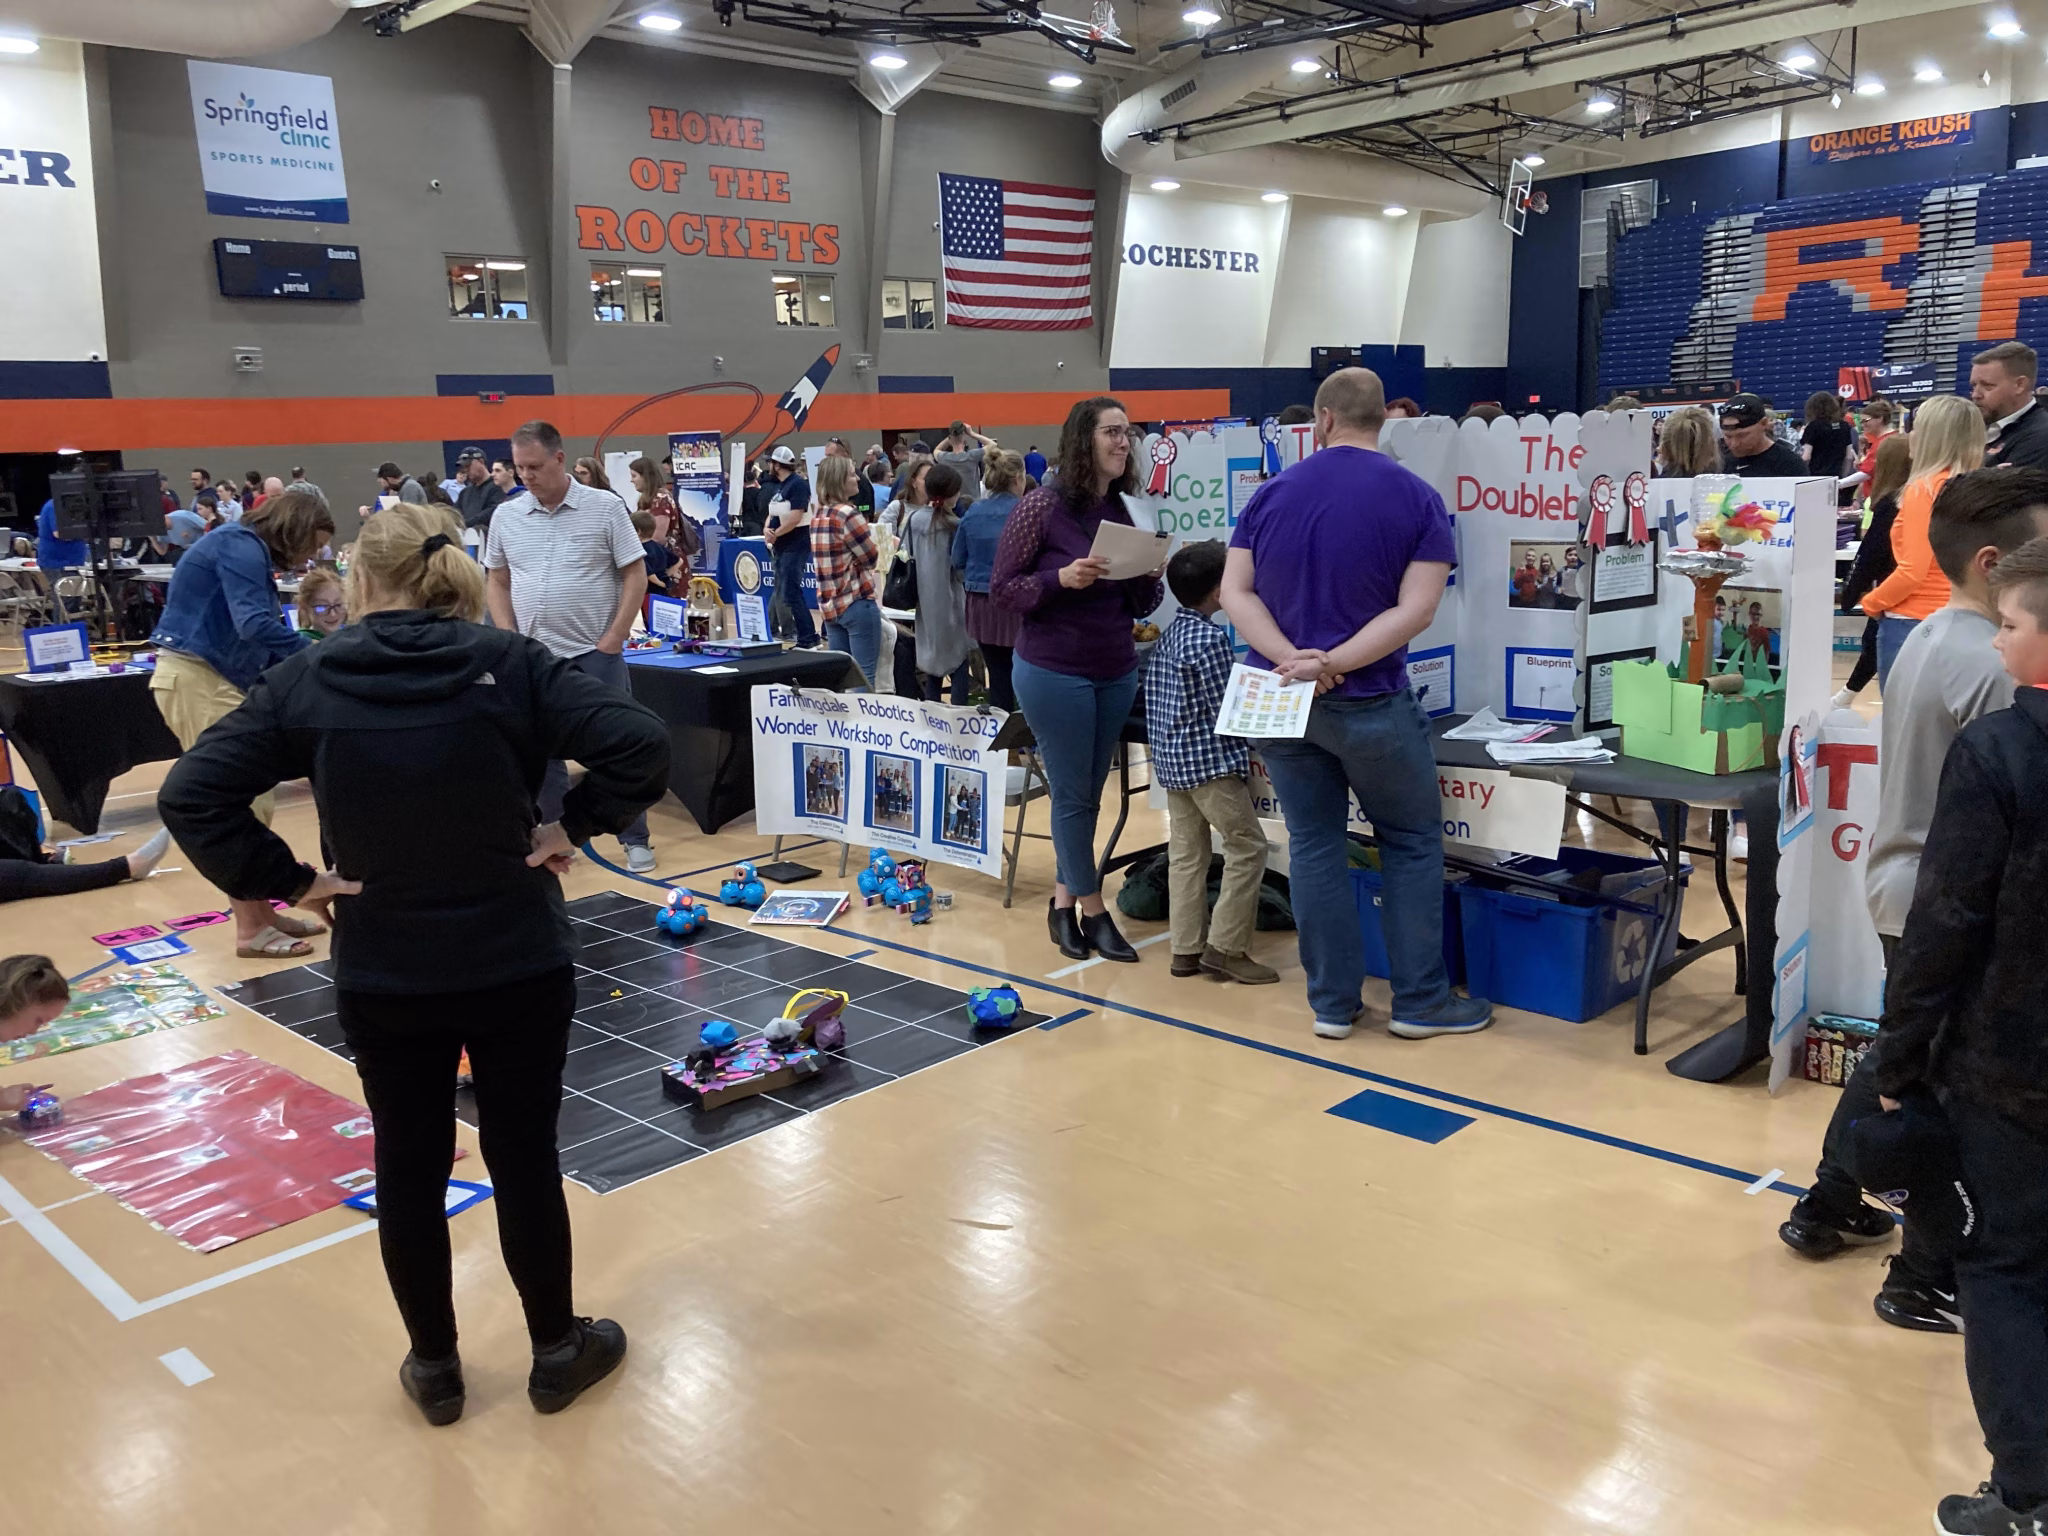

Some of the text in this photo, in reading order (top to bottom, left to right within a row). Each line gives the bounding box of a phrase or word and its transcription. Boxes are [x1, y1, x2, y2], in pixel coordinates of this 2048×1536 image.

[204, 98, 328, 131] Springfield
[280, 129, 331, 149] clinic
[649, 105, 765, 151] HOME
[1810, 112, 1972, 153] ORANGE KRUSH
[211, 151, 335, 172] SPORTS MEDICINE
[1828, 150, 1871, 161] Prepare
[1875, 146, 1885, 154] to
[1888, 142, 1900, 153] be
[630, 157, 791, 203] OF THE
[575, 205, 840, 265] ROCKETS
[225, 242, 357, 260] Home Guests
[282, 282, 310, 293] period
[1520, 434, 1587, 474] The
[1158, 507, 1225, 533] Doez
[1605, 552, 1645, 566] Problem
[1412, 660, 1444, 674] Solution
[1527, 656, 1572, 669] Blueprint
[768, 689, 999, 738] Farmingdale Robotics Team 2023
[756, 716, 980, 764] Wonder Workshop Competition
